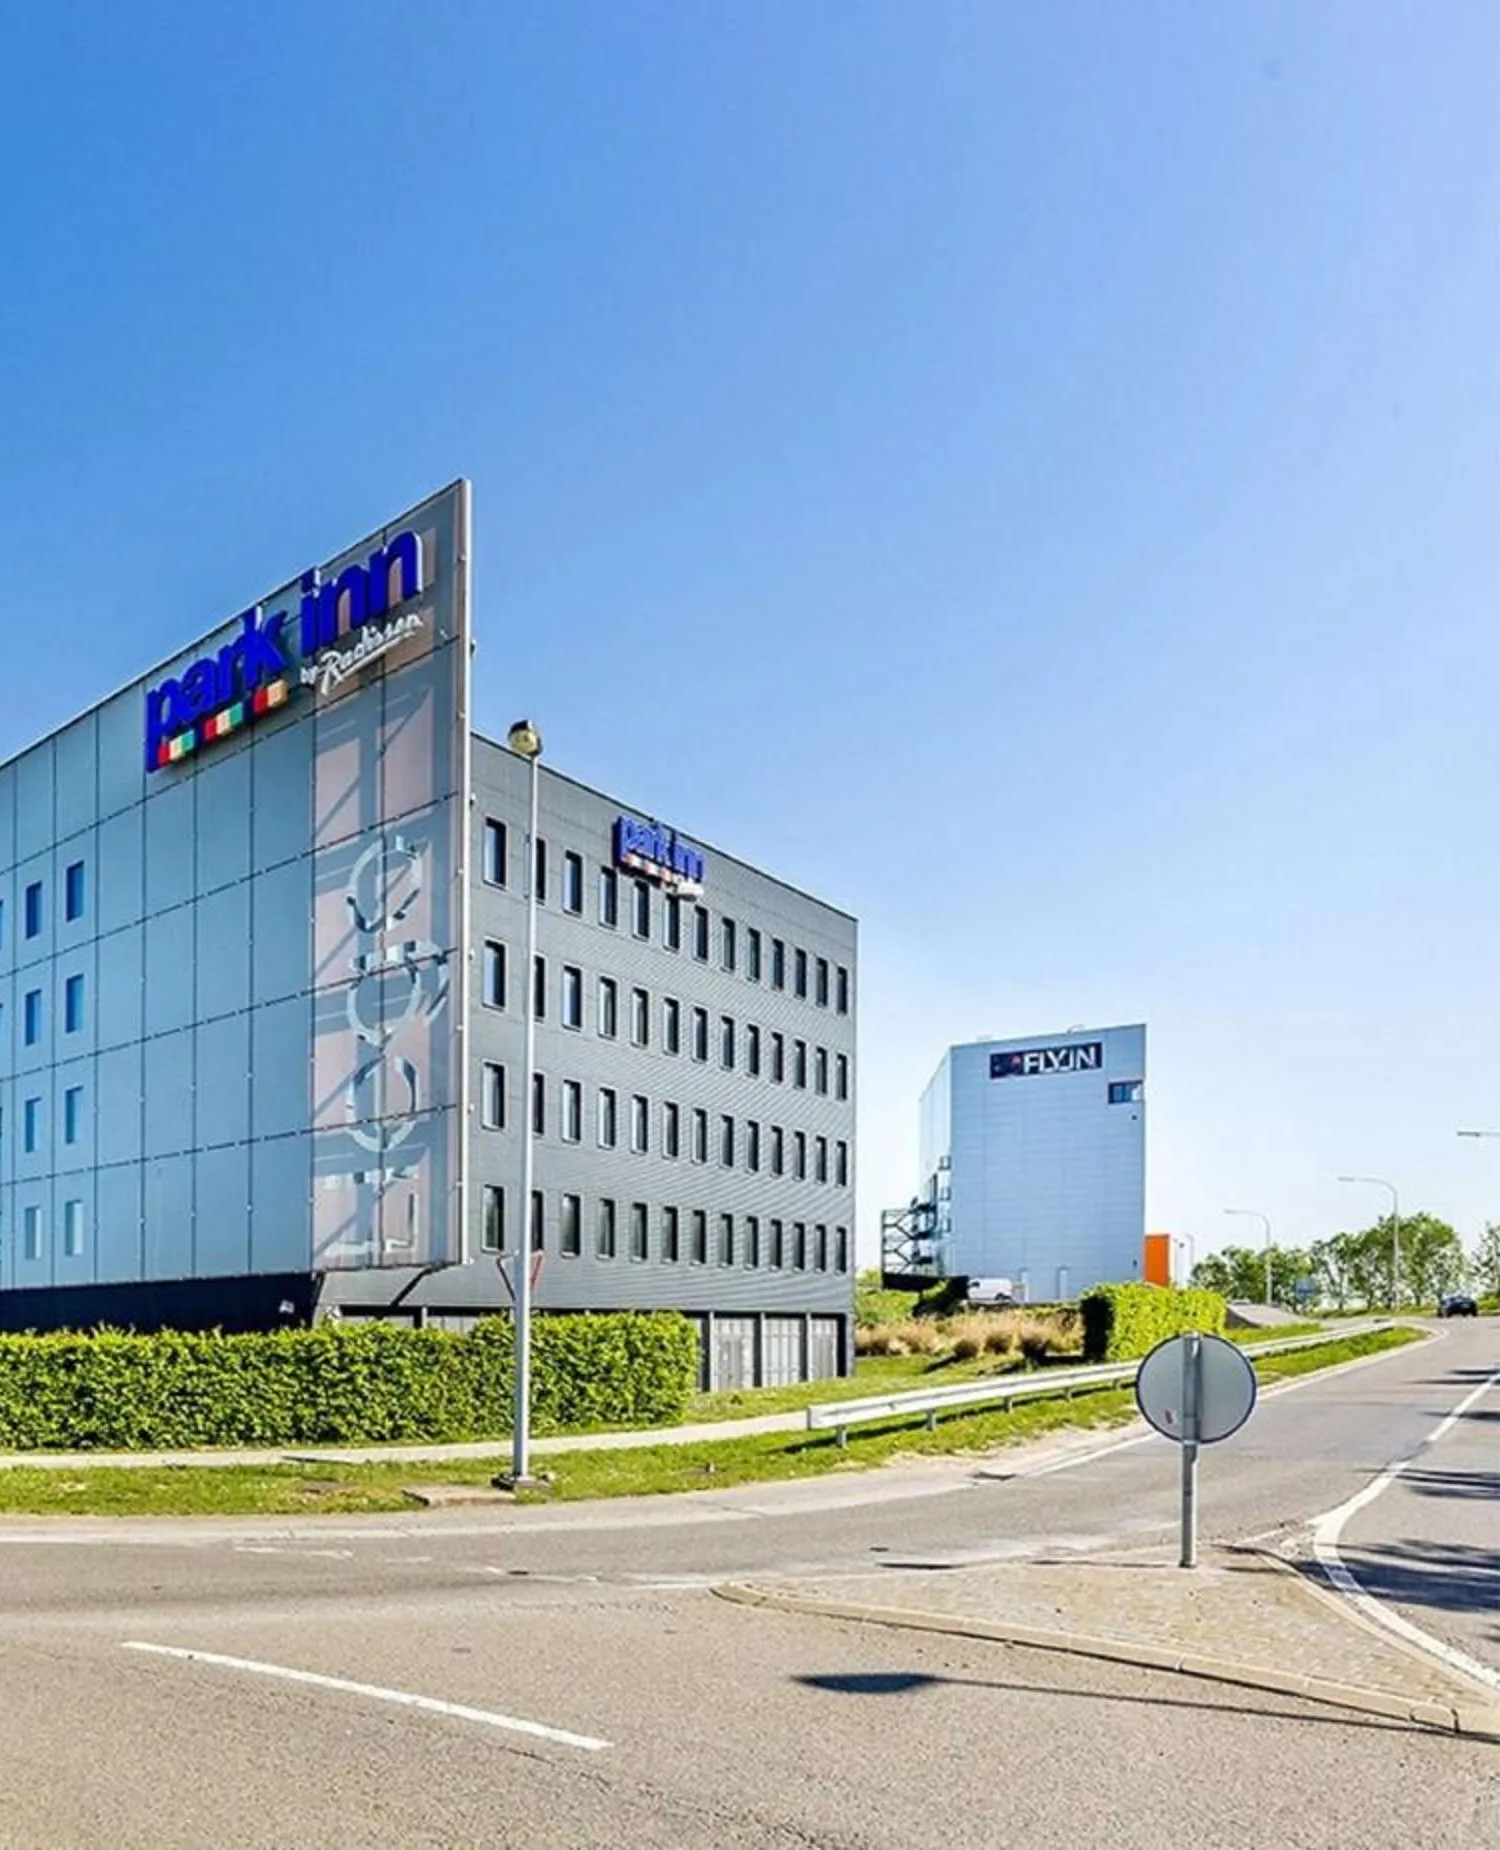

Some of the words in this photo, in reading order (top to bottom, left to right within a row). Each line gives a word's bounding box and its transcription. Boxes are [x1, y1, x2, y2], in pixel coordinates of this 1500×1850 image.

[146, 602, 288, 774] park
[300, 528, 423, 658] inn
[319, 613, 424, 696] Radisson
[613, 815, 670, 864] park
[671, 830, 706, 883] inn
